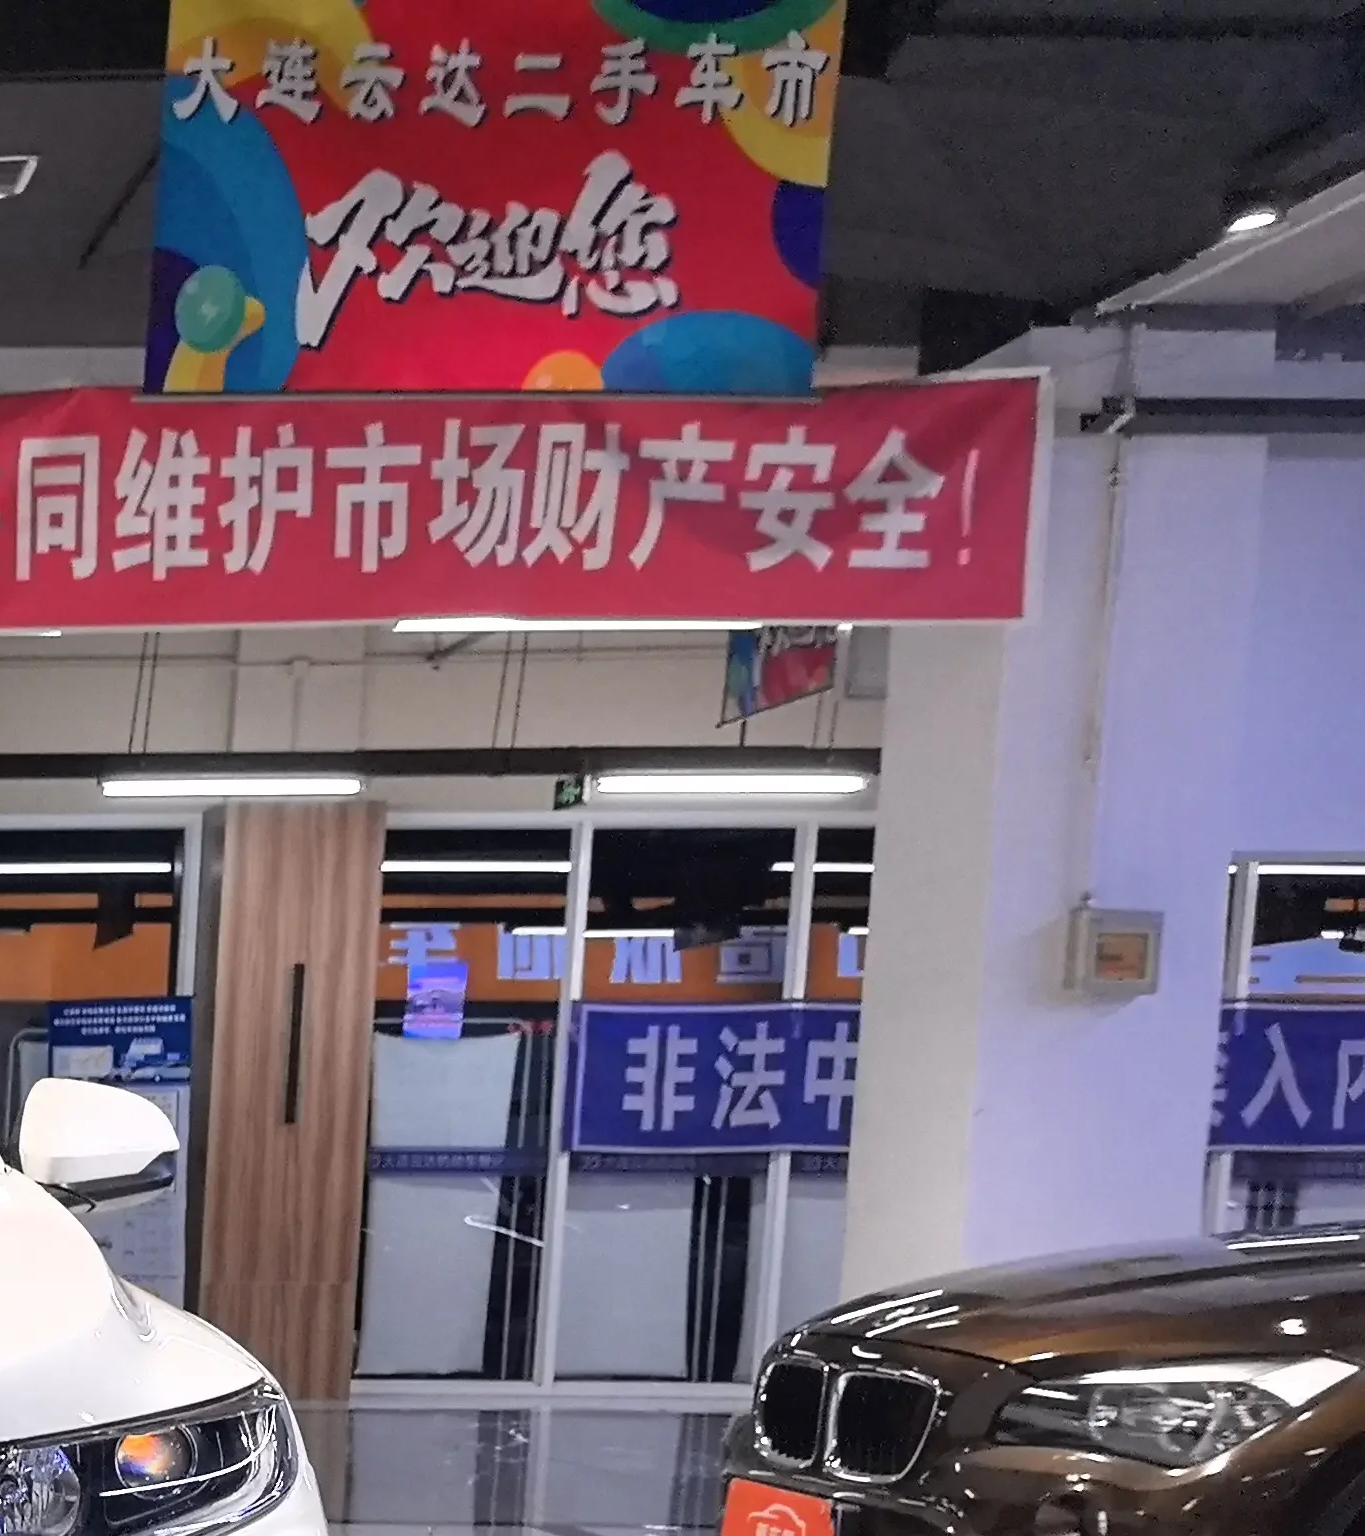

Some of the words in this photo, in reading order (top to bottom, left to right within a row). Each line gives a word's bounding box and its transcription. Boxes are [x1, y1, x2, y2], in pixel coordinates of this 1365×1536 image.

[172, 29, 831, 129] 大连云达二手车市
[295, 149, 678, 350] 欢迎您
